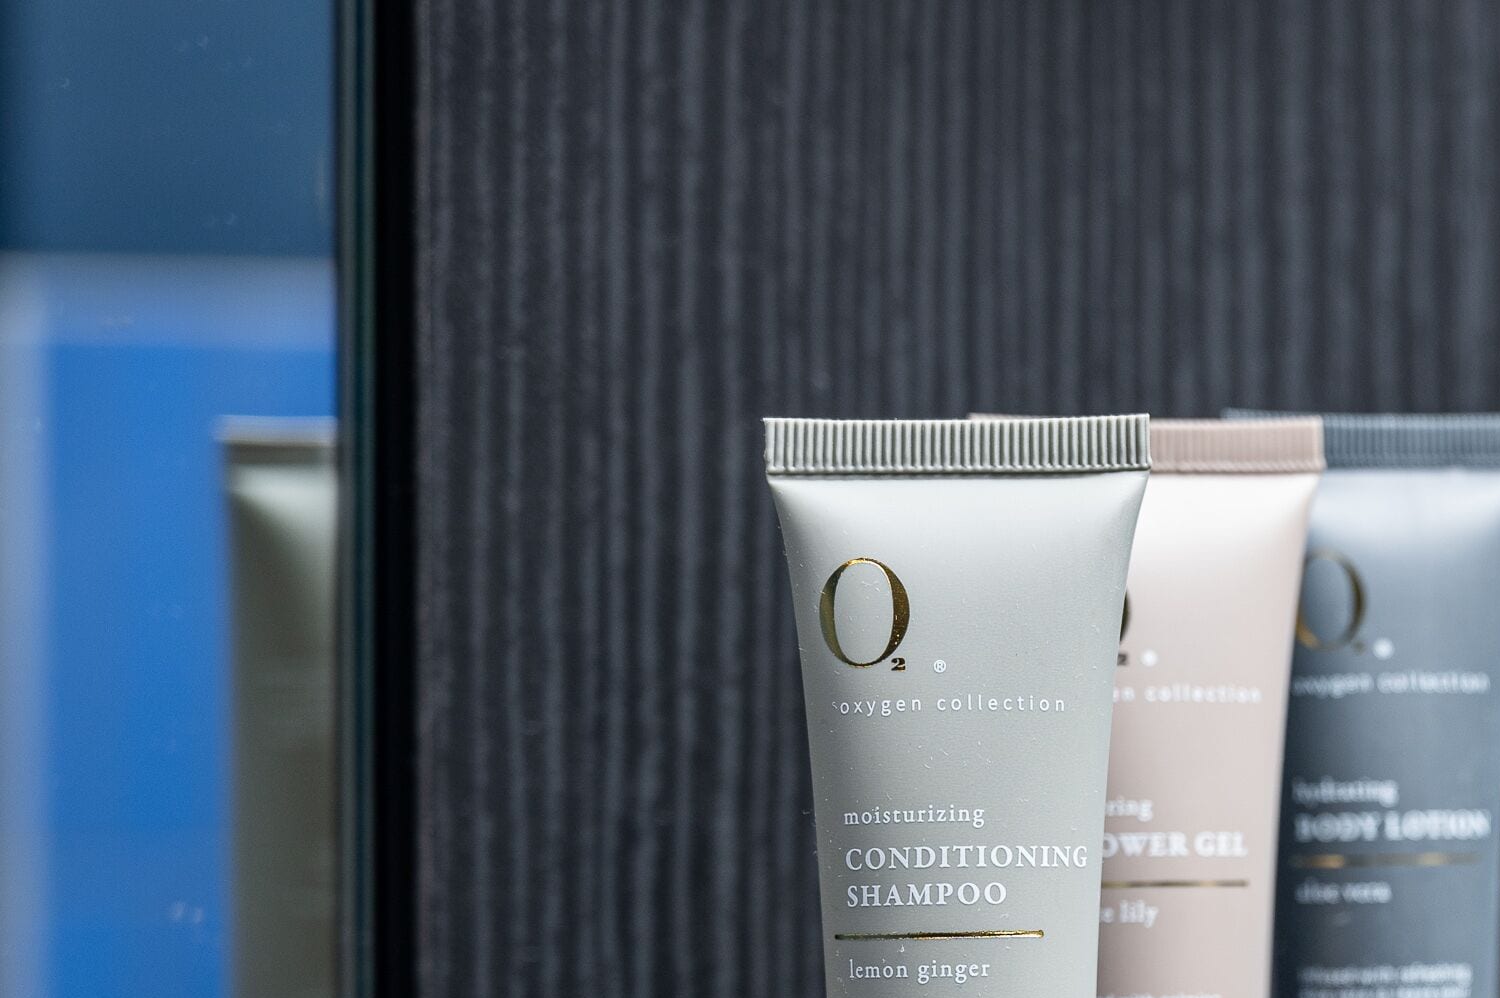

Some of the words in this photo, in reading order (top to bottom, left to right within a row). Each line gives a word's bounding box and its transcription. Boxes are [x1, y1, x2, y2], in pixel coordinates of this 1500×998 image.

[839, 697, 921, 716] oxygen
[937, 695, 1065, 712] collection
[1144, 683, 1263, 703] collection
[843, 804, 985, 828] moisturizing
[1383, 809, 1491, 840] LOTION
[1102, 831, 1189, 858] OWER
[1194, 830, 1249, 858] GEL
[845, 845, 1088, 871] CONDITIONING
[847, 882, 1007, 908] SHAMPOO
[1119, 900, 1160, 928] lily
[849, 959, 909, 980] lemon
[917, 960, 991, 984] ginger
